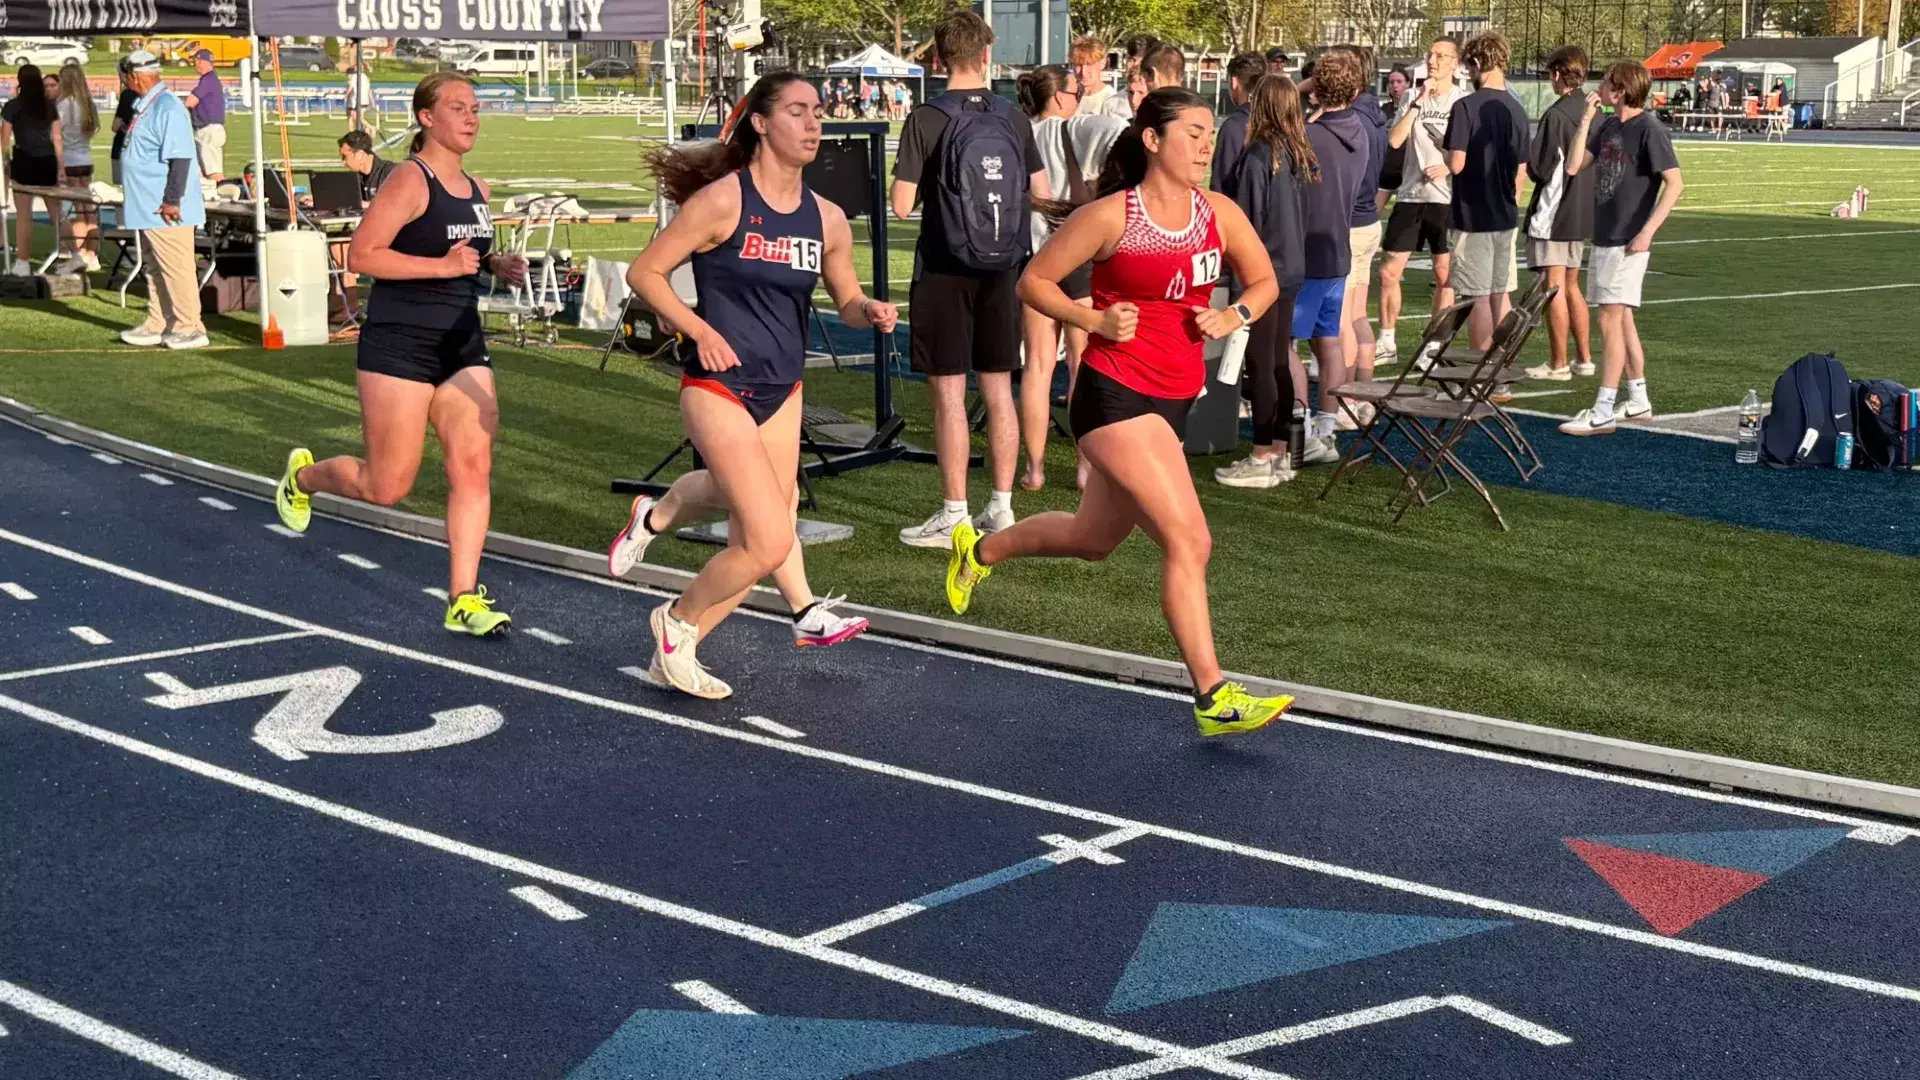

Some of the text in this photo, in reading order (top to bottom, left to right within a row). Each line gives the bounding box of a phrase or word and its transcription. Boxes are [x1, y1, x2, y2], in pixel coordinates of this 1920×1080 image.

[337, 0, 603, 32] CROSS COUNTRY
[793, 240, 818, 270] 15
[1200, 251, 1218, 283] 12
[144, 665, 504, 761] 2
